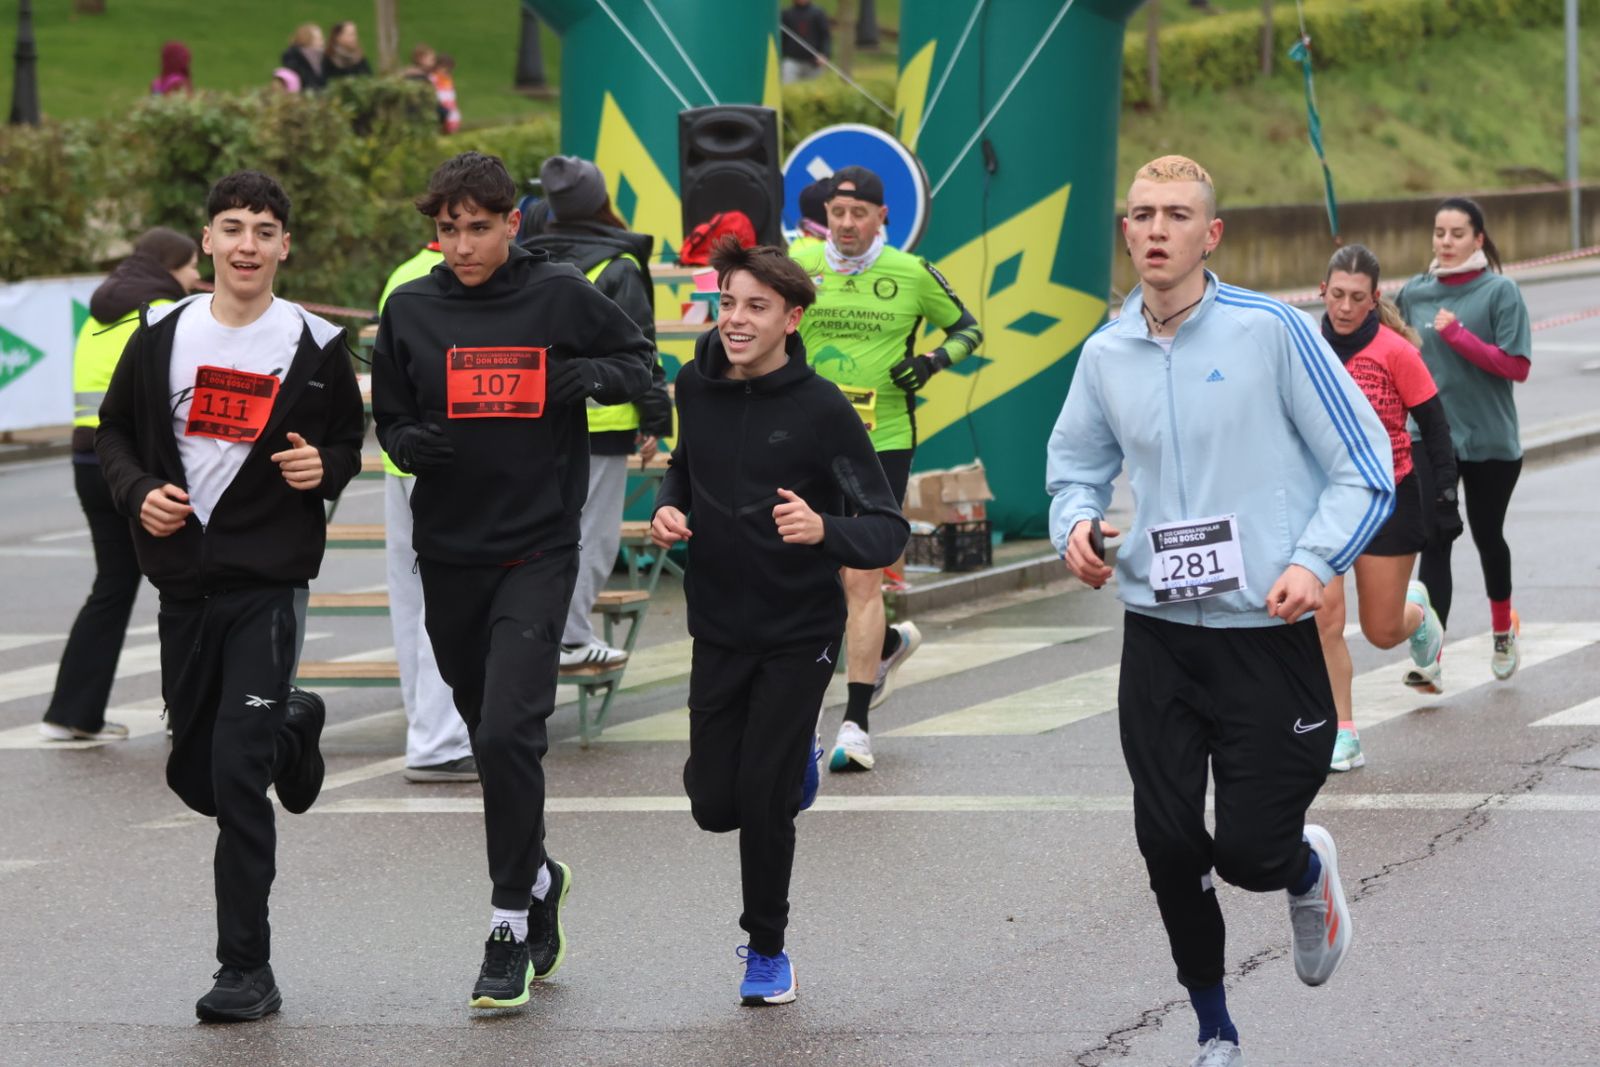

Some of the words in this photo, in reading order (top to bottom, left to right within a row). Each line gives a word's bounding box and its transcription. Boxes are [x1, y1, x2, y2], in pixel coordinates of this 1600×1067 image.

[804, 308, 896, 321] ORRECAMINOS
[811, 320, 882, 333] CARBAJOSA
[493, 357, 519, 365] BOSCO
[209, 377, 225, 385] DON
[226, 379, 251, 389] BOSCO
[471, 373, 521, 396] 107
[199, 393, 249, 422] 111
[1179, 532, 1206, 543] BOSCO
[1161, 549, 1225, 582] 281
